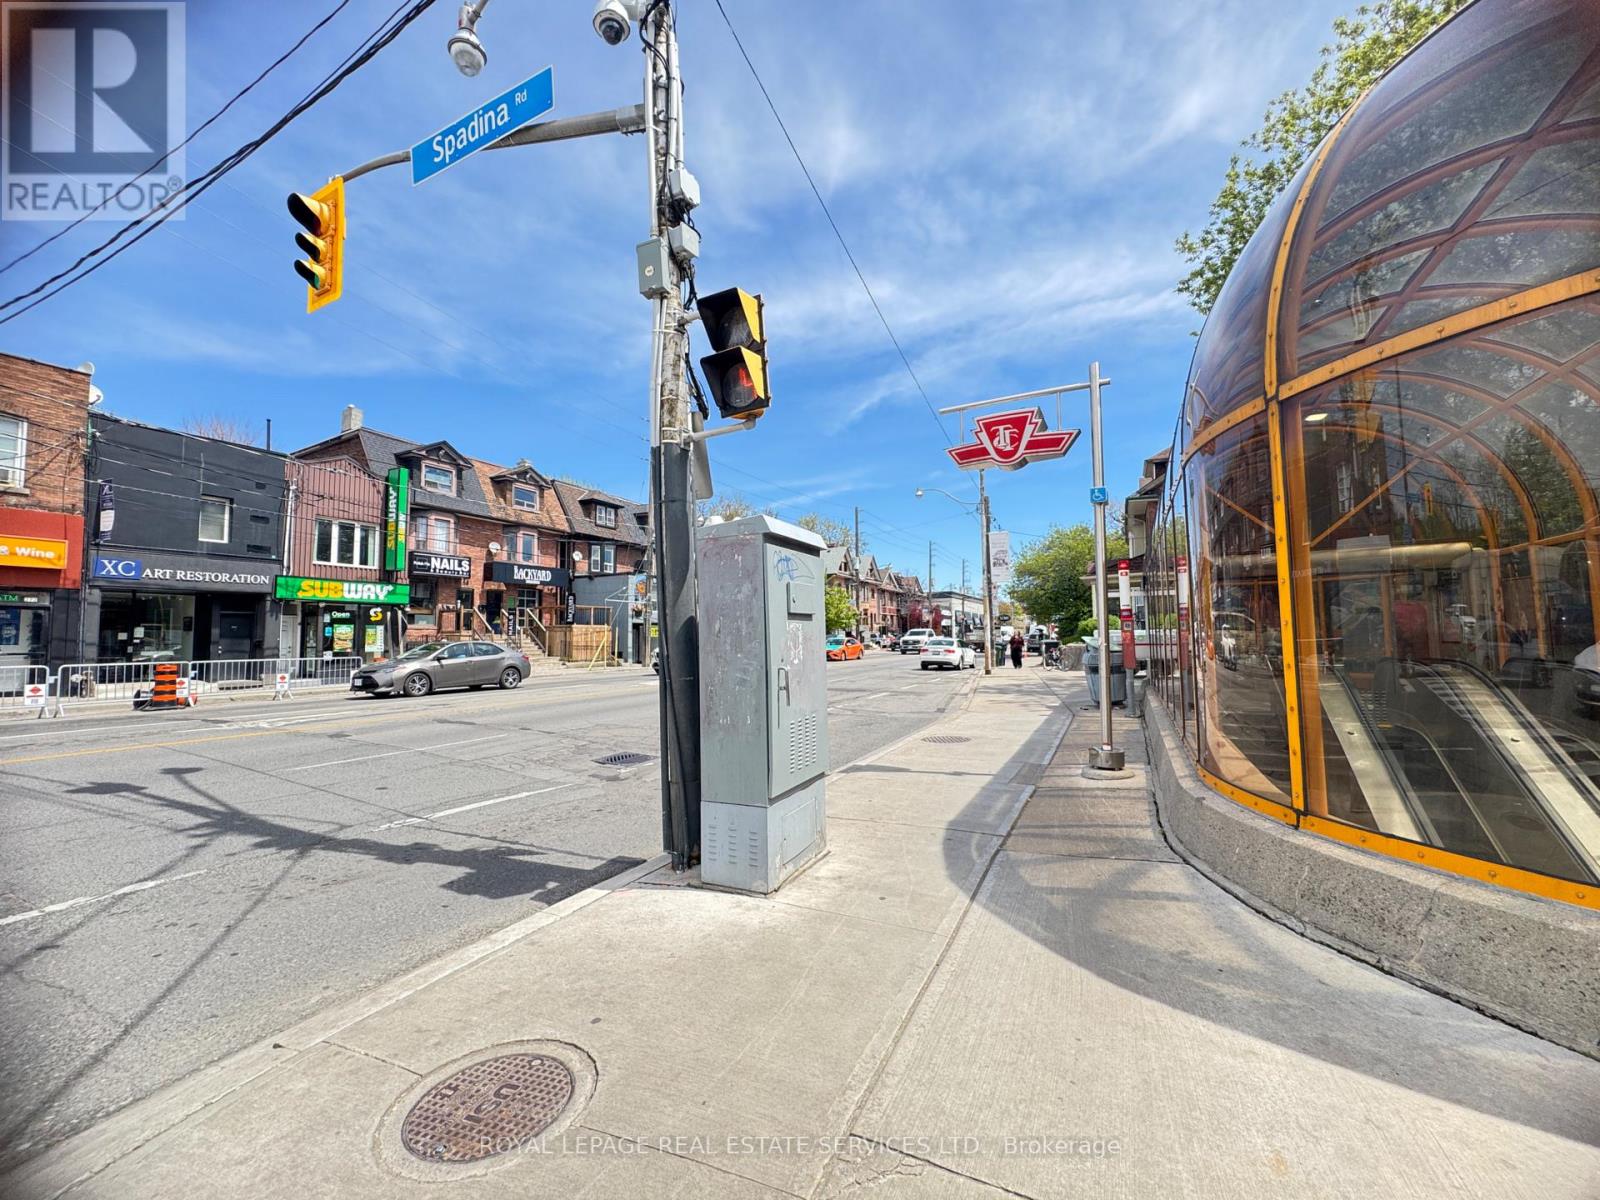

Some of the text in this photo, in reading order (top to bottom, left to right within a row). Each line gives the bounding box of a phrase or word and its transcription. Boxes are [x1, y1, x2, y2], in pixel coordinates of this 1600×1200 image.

[432, 88, 528, 163] Spadina Rd
[387, 487, 398, 550] SUBWAY
[15, 546, 55, 559] Wine
[100, 559, 270, 585] XC ART RESTORATION
[430, 556, 470, 572] NAILS
[513, 565, 552, 583] BACKYARD
[297, 579, 394, 601] SUBWAY
[331, 611, 351, 620] Open
